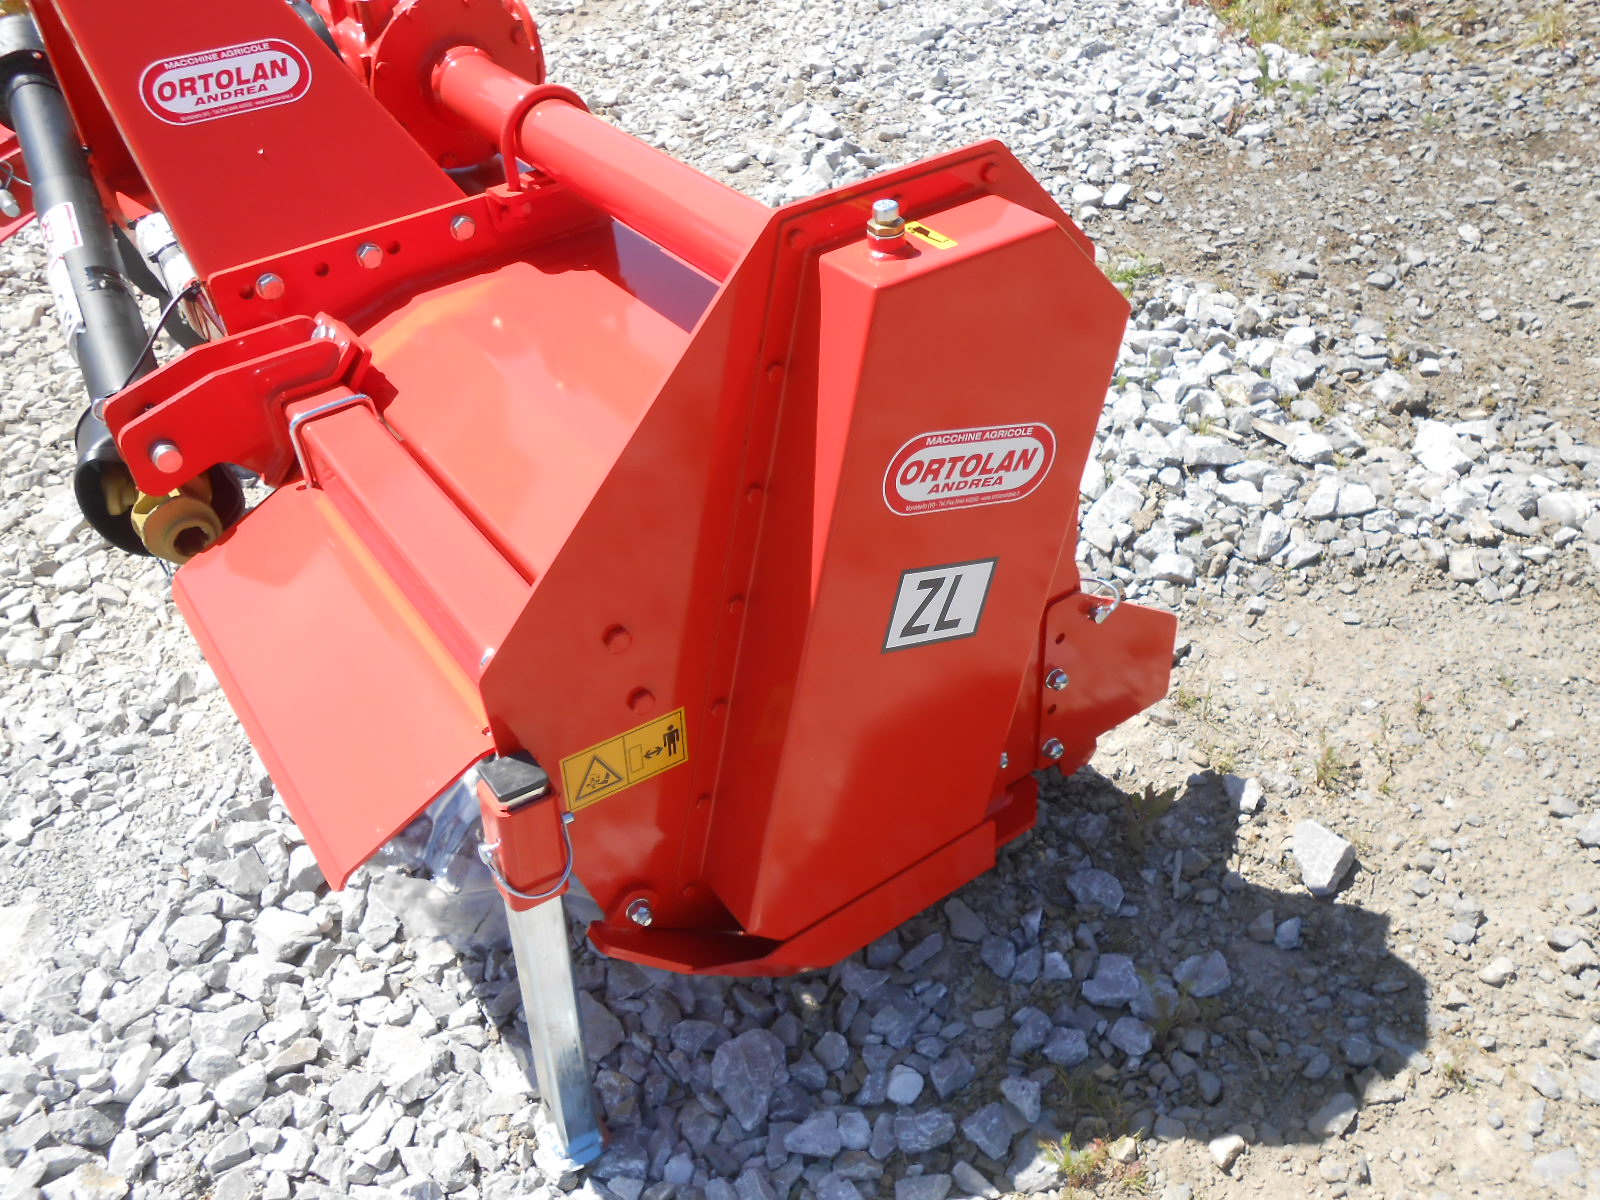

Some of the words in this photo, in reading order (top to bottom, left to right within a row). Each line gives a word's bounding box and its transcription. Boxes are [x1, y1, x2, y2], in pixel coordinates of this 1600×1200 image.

[164, 53, 218, 70] MACCHINE
[220, 42, 271, 60] AGRICOLE
[157, 57, 289, 102] ORTOLAN
[194, 83, 269, 106] ANDREA
[925, 432, 982, 446] MACCHINE
[983, 427, 1034, 440] AGRICOLE
[899, 447, 1039, 486] ORTOLAN
[927, 475, 1005, 495] ANDREA
[899, 574, 963, 638] ZL
